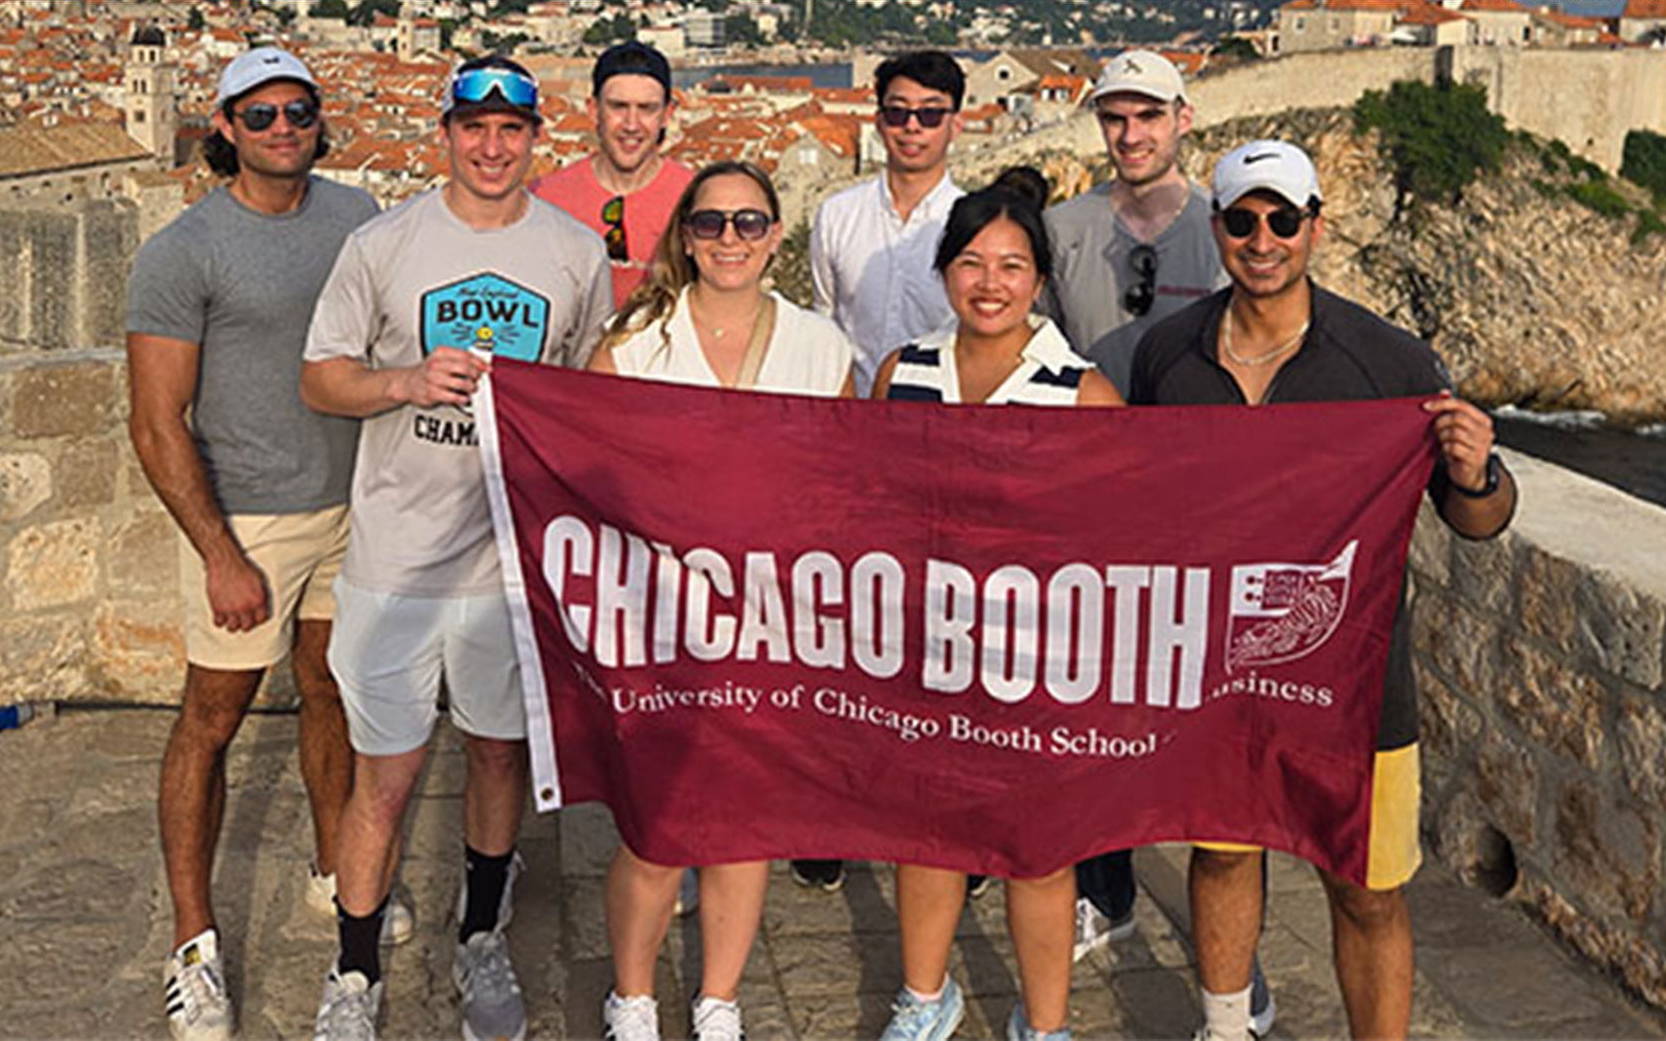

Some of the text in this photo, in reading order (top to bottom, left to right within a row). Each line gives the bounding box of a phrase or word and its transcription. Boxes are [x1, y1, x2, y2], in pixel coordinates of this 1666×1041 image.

[437, 298, 539, 329] BOWL
[414, 414, 480, 446] CHAM
[543, 515, 1211, 710] CHICAGO BOOTH
[612, 681, 763, 714] University
[771, 686, 805, 710] of
[814, 688, 940, 742] Chicago
[949, 714, 1042, 752] Booth
[1050, 728, 1156, 758] School
